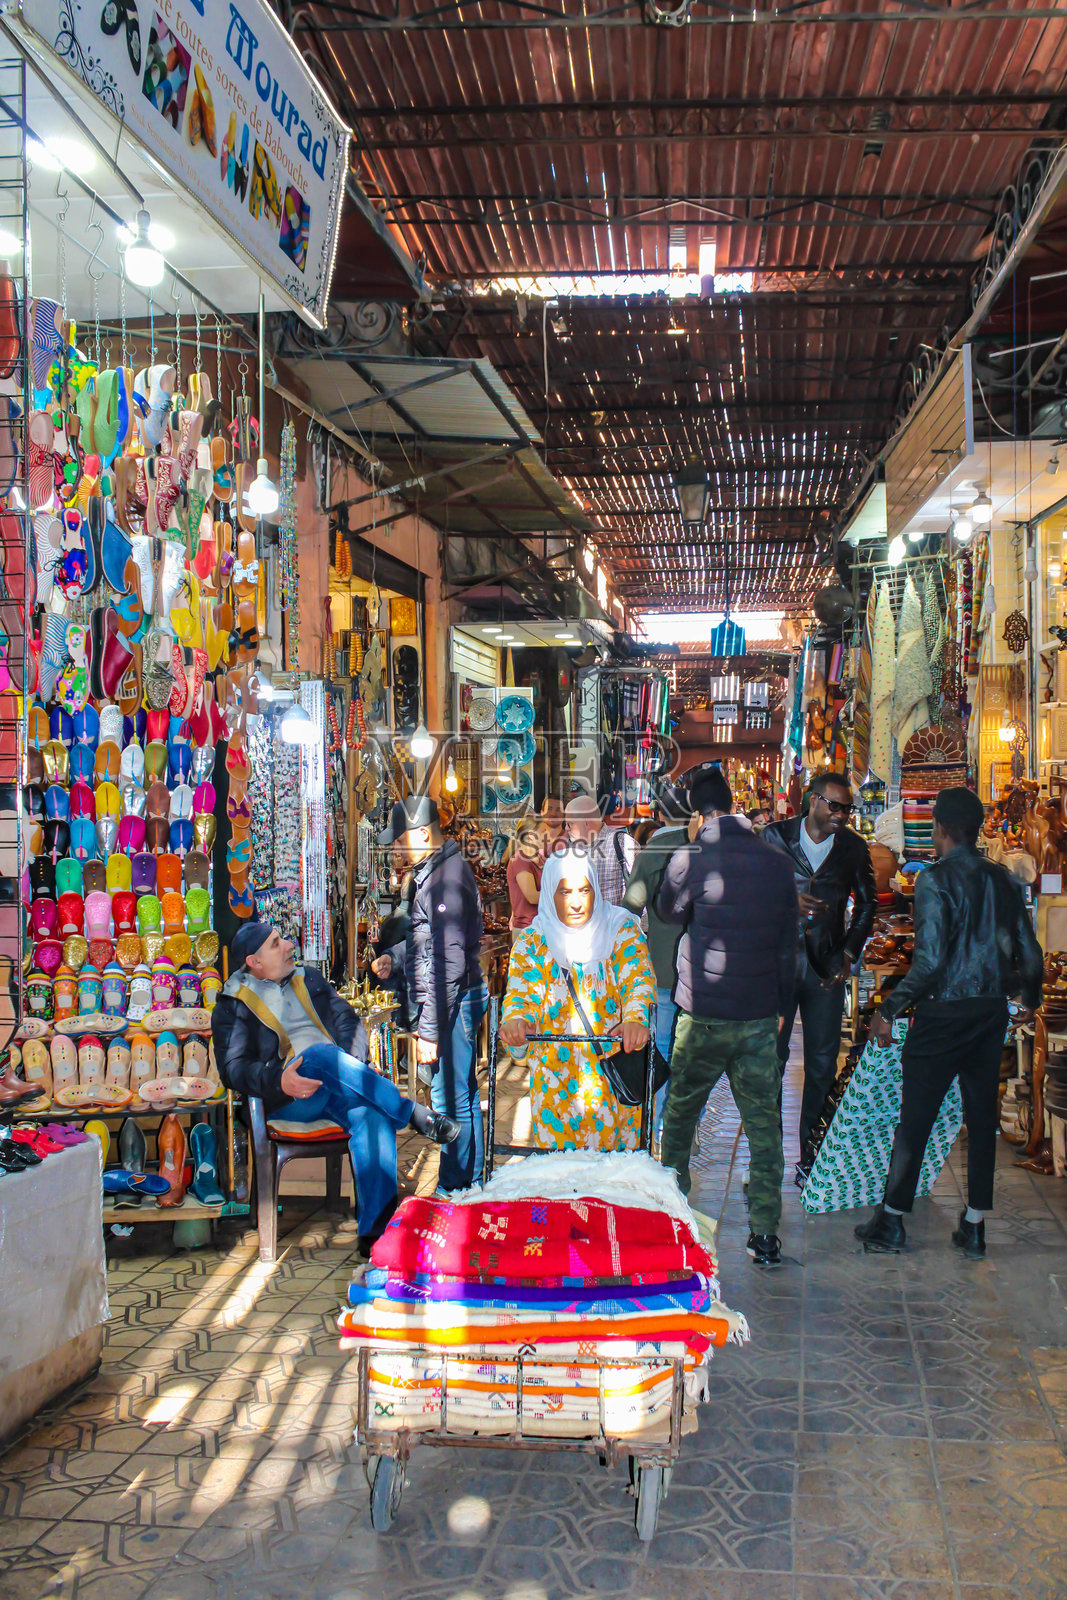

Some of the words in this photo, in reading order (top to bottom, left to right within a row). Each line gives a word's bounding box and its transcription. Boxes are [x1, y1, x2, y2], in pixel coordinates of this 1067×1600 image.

[176, 11, 213, 72] toutes
[216, 65, 247, 115] sortes
[249, 103, 262, 135] de
[264, 119, 308, 194] Babouche
[225, 2, 328, 181] Mourad
